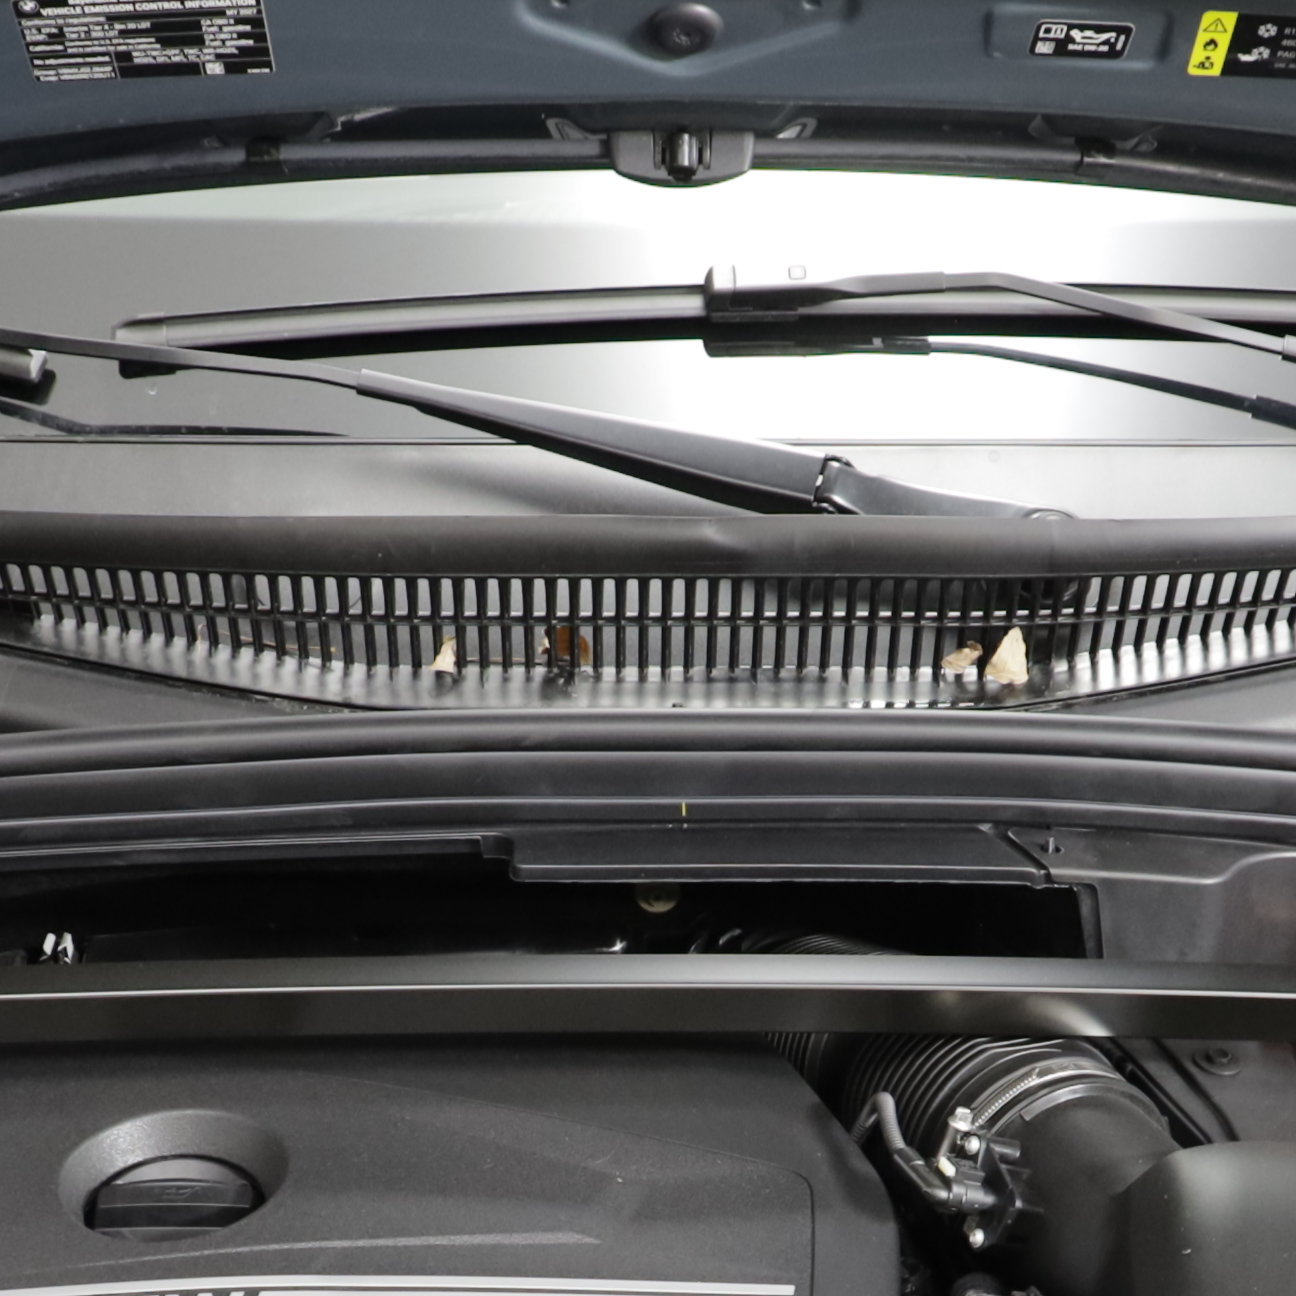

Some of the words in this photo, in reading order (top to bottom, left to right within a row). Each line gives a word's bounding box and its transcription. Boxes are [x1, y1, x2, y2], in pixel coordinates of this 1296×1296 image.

[40, 6, 83, 16] VEHICLE
[84, 3, 134, 14] EMISSION
[135, 1, 183, 11] CONTROL
[184, 0, 256, 9] INFORMATION
[1276, 51, 1296, 59] PAG
